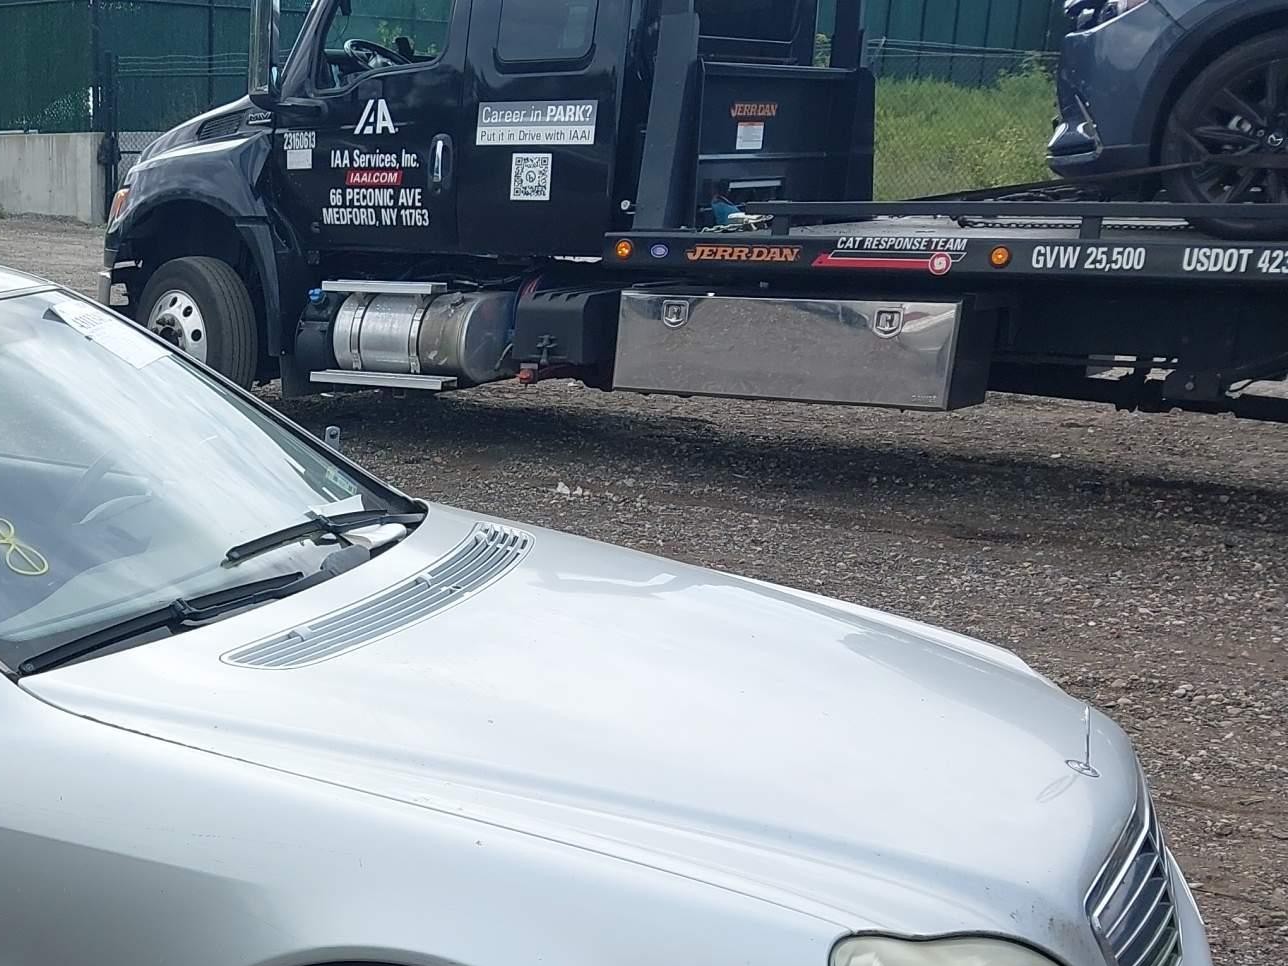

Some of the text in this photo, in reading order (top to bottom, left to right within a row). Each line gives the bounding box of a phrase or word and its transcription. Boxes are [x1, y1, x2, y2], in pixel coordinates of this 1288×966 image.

[482, 104, 593, 123] Career in PARK?
[283, 131, 316, 150] 23160613
[480, 129, 591, 142] Put it in Drive with IAAI
[330, 149, 419, 169] IAA Services, Inc.
[349, 172, 398, 183] IAAI.COM
[329, 188, 422, 206] 66 PECONIC AVE
[322, 207, 429, 226] MEDFORD, NY 11763
[837, 237, 968, 251] CAT RESPONSE TEAM
[1031, 246, 1146, 272] GVW 25,500
[1182, 247, 1253, 272] USDOT
